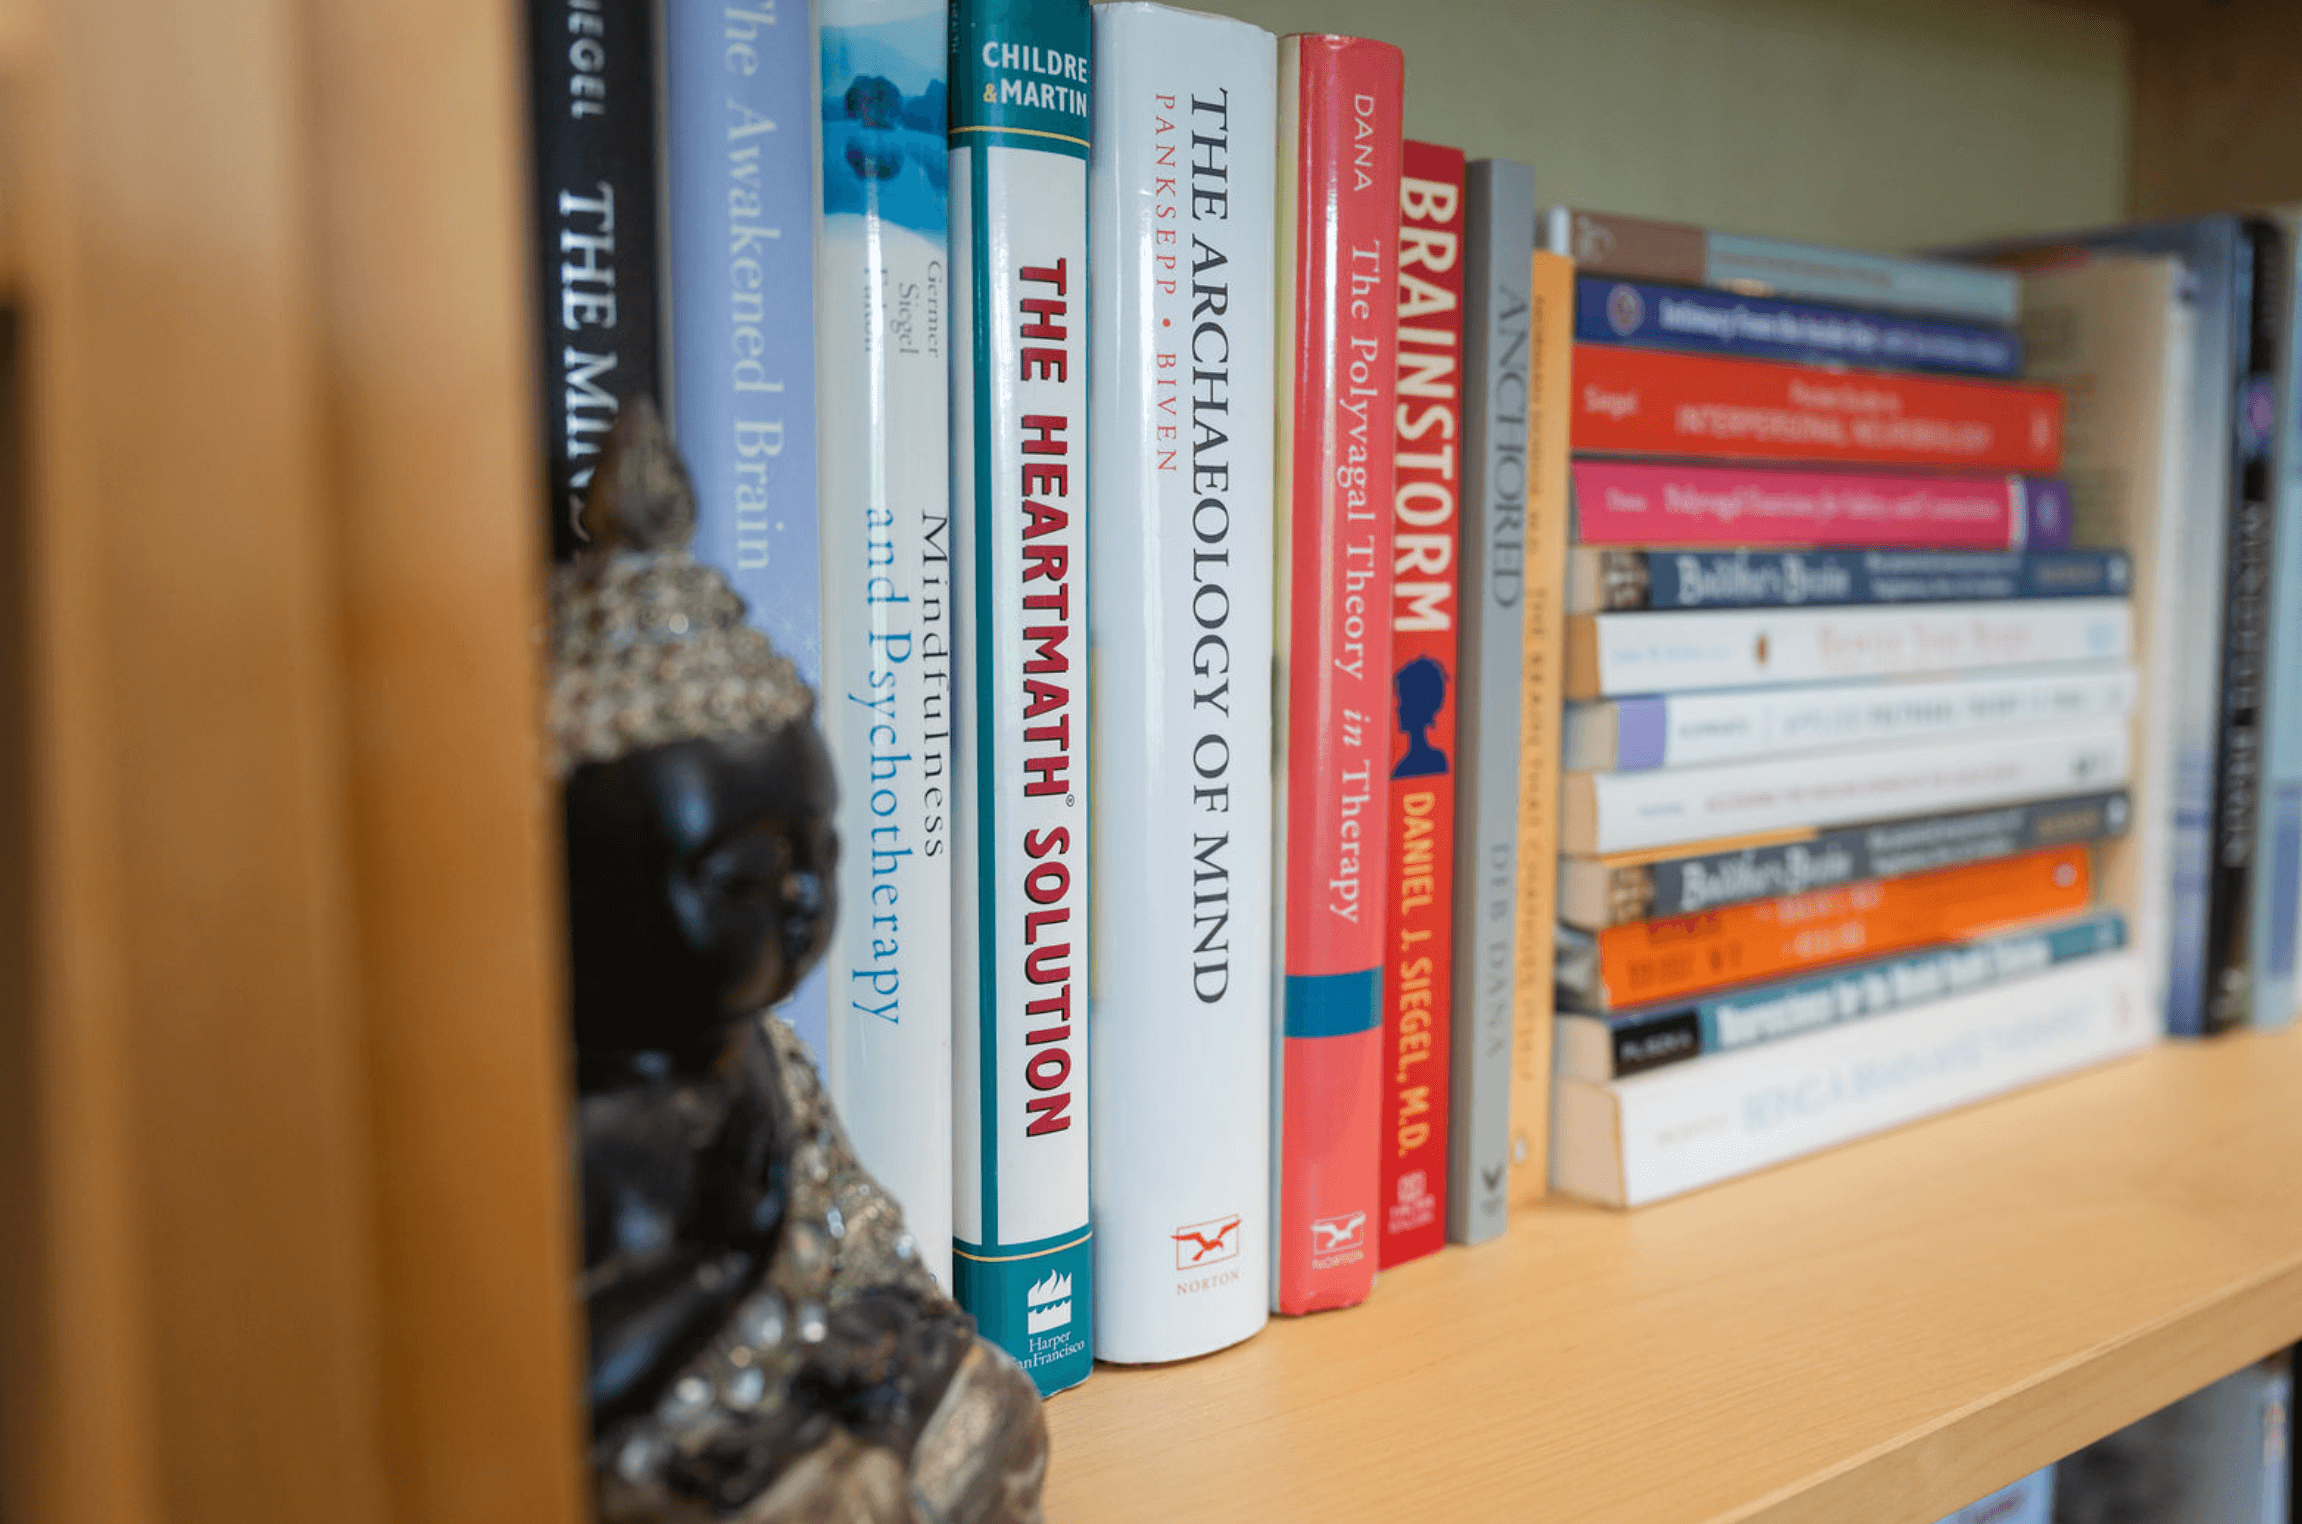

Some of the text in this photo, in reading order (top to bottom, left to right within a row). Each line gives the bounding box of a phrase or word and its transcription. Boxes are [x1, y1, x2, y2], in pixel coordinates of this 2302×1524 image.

[982, 41, 1088, 84] CHILDRE
[1353, 94, 1375, 193] DANA
[558, 180, 617, 331] THE
[724, 0, 785, 570] he Awakened Brain
[890, 282, 919, 354] Siegel
[927, 260, 942, 358] Germer
[1155, 93, 1177, 471] PANKSEPP BIVEN
[1020, 257, 1067, 382] THE
[1394, 176, 1459, 633] BRAINSTORM
[1492, 284, 1528, 608] ANCHORED
[1191, 87, 1230, 1003] THE ARCHAEOLOGY OF MIND
[1328, 239, 1380, 925] The Polyvagal Theory in Therapy
[920, 509, 950, 857] Mindfulness
[849, 508, 913, 1026] and Psychotherapy
[1401, 791, 1435, 916] DANIEL
[1024, 827, 1072, 1139] SOLUTION
[1400, 928, 1433, 951] J.
[1398, 1085, 1430, 1158] M.D.
[1029, 1331, 1071, 1354] Harper
[1177, 1269, 1240, 1297] NORTON
[1014, 1340, 1086, 1371] anFrancisco
